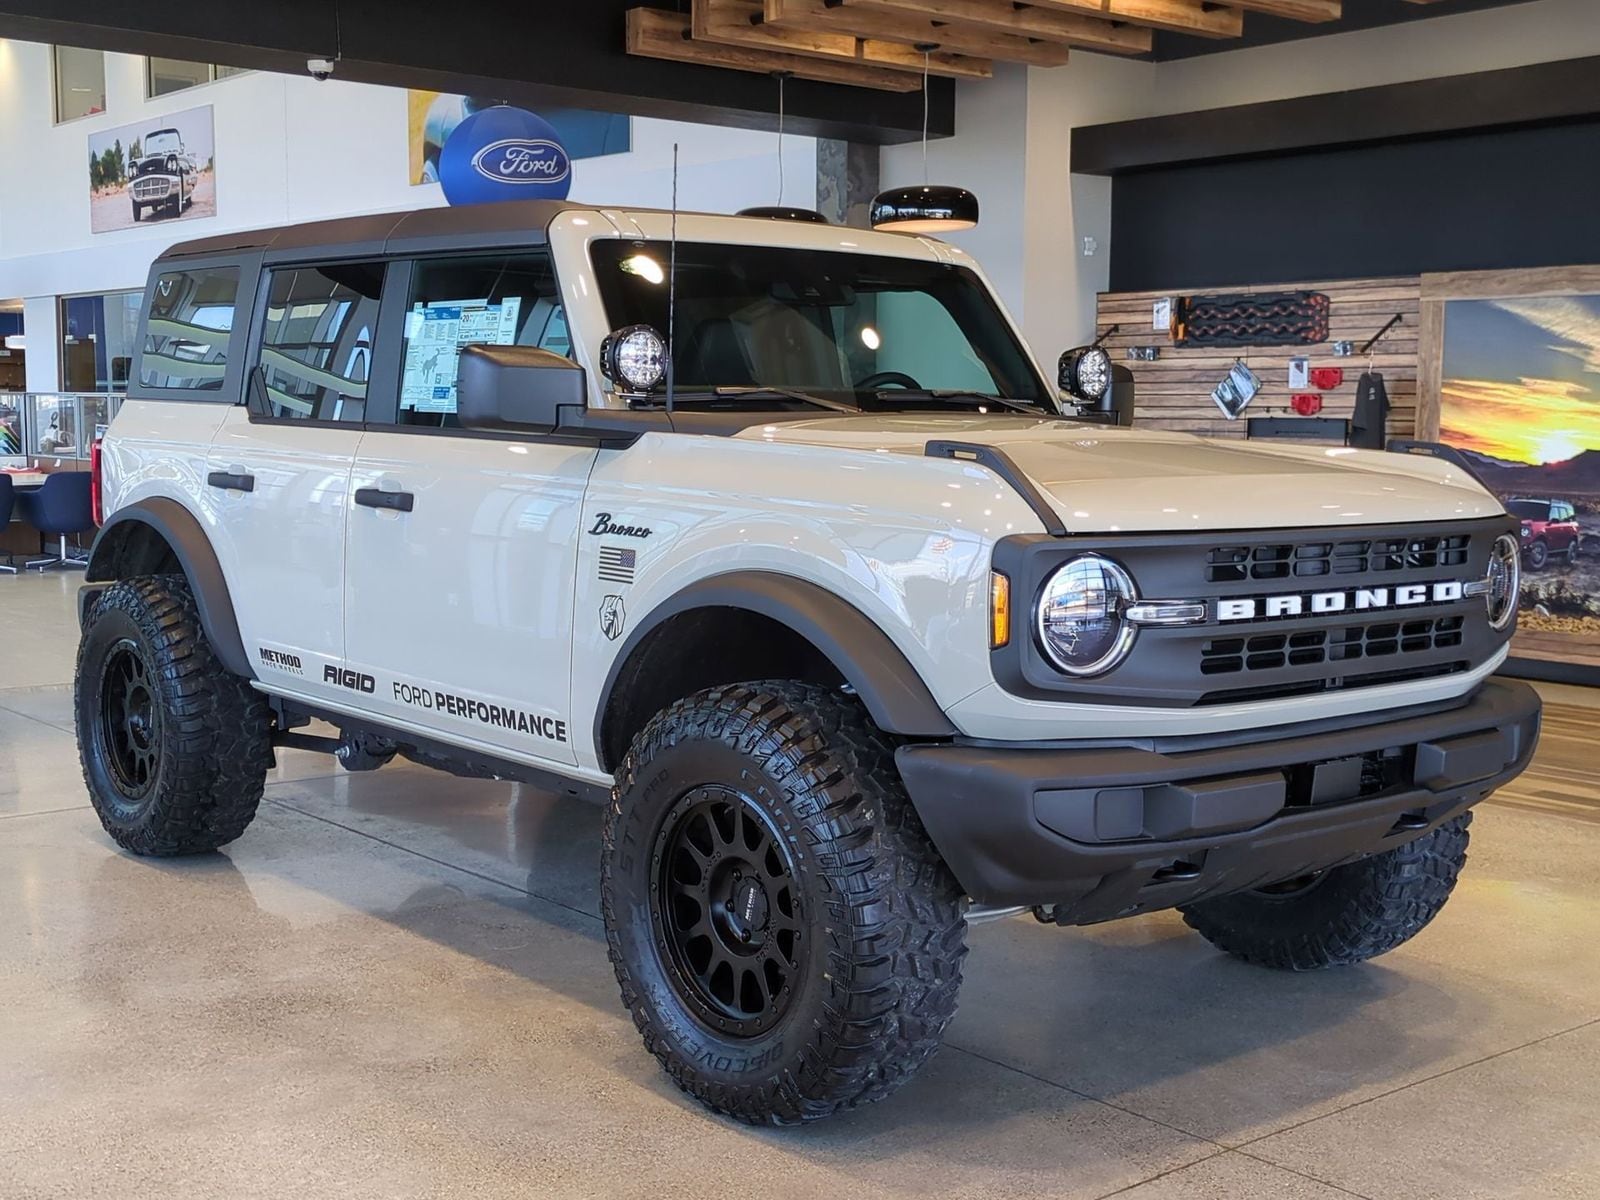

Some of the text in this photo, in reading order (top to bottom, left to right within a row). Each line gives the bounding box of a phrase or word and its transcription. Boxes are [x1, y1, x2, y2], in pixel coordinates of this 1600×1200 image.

[500, 147, 558, 174] Ford
[588, 512, 653, 539] Bronco
[1217, 581, 1462, 621] BRONCO
[259, 647, 302, 669] METHOD
[323, 664, 376, 694] RIGID
[392, 681, 567, 742] FORD PERFORMANCE
